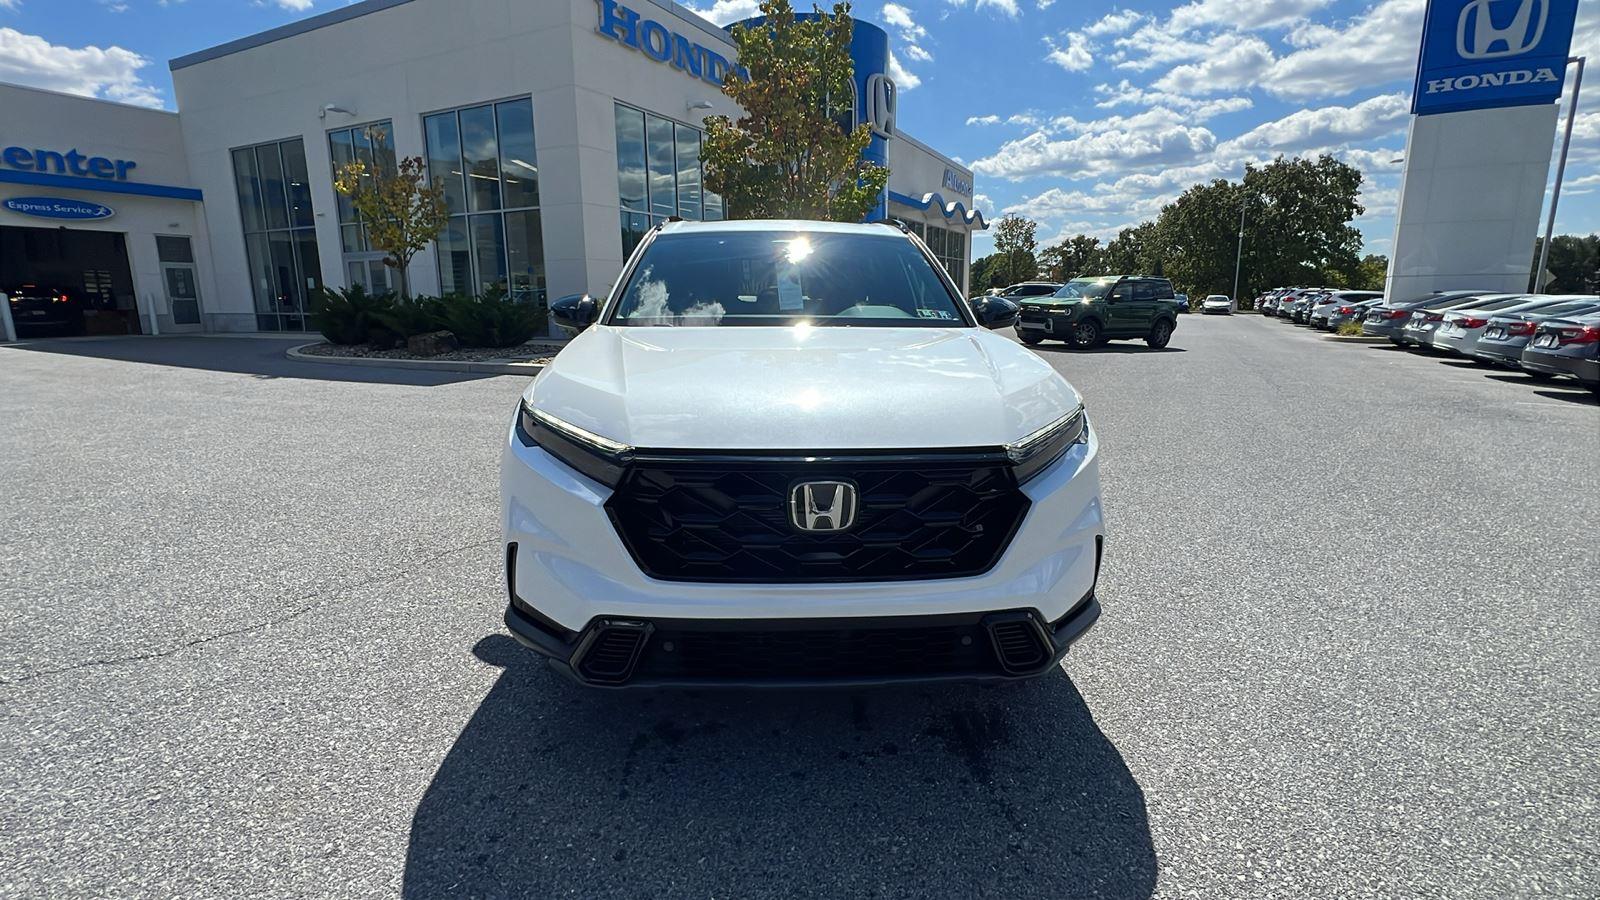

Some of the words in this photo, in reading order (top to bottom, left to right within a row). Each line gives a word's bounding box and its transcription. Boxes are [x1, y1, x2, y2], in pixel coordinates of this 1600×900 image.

[1425, 68, 1558, 94] HONDA
[0, 146, 136, 180] enter
[8, 201, 51, 212] Express
[54, 204, 92, 215] Service
